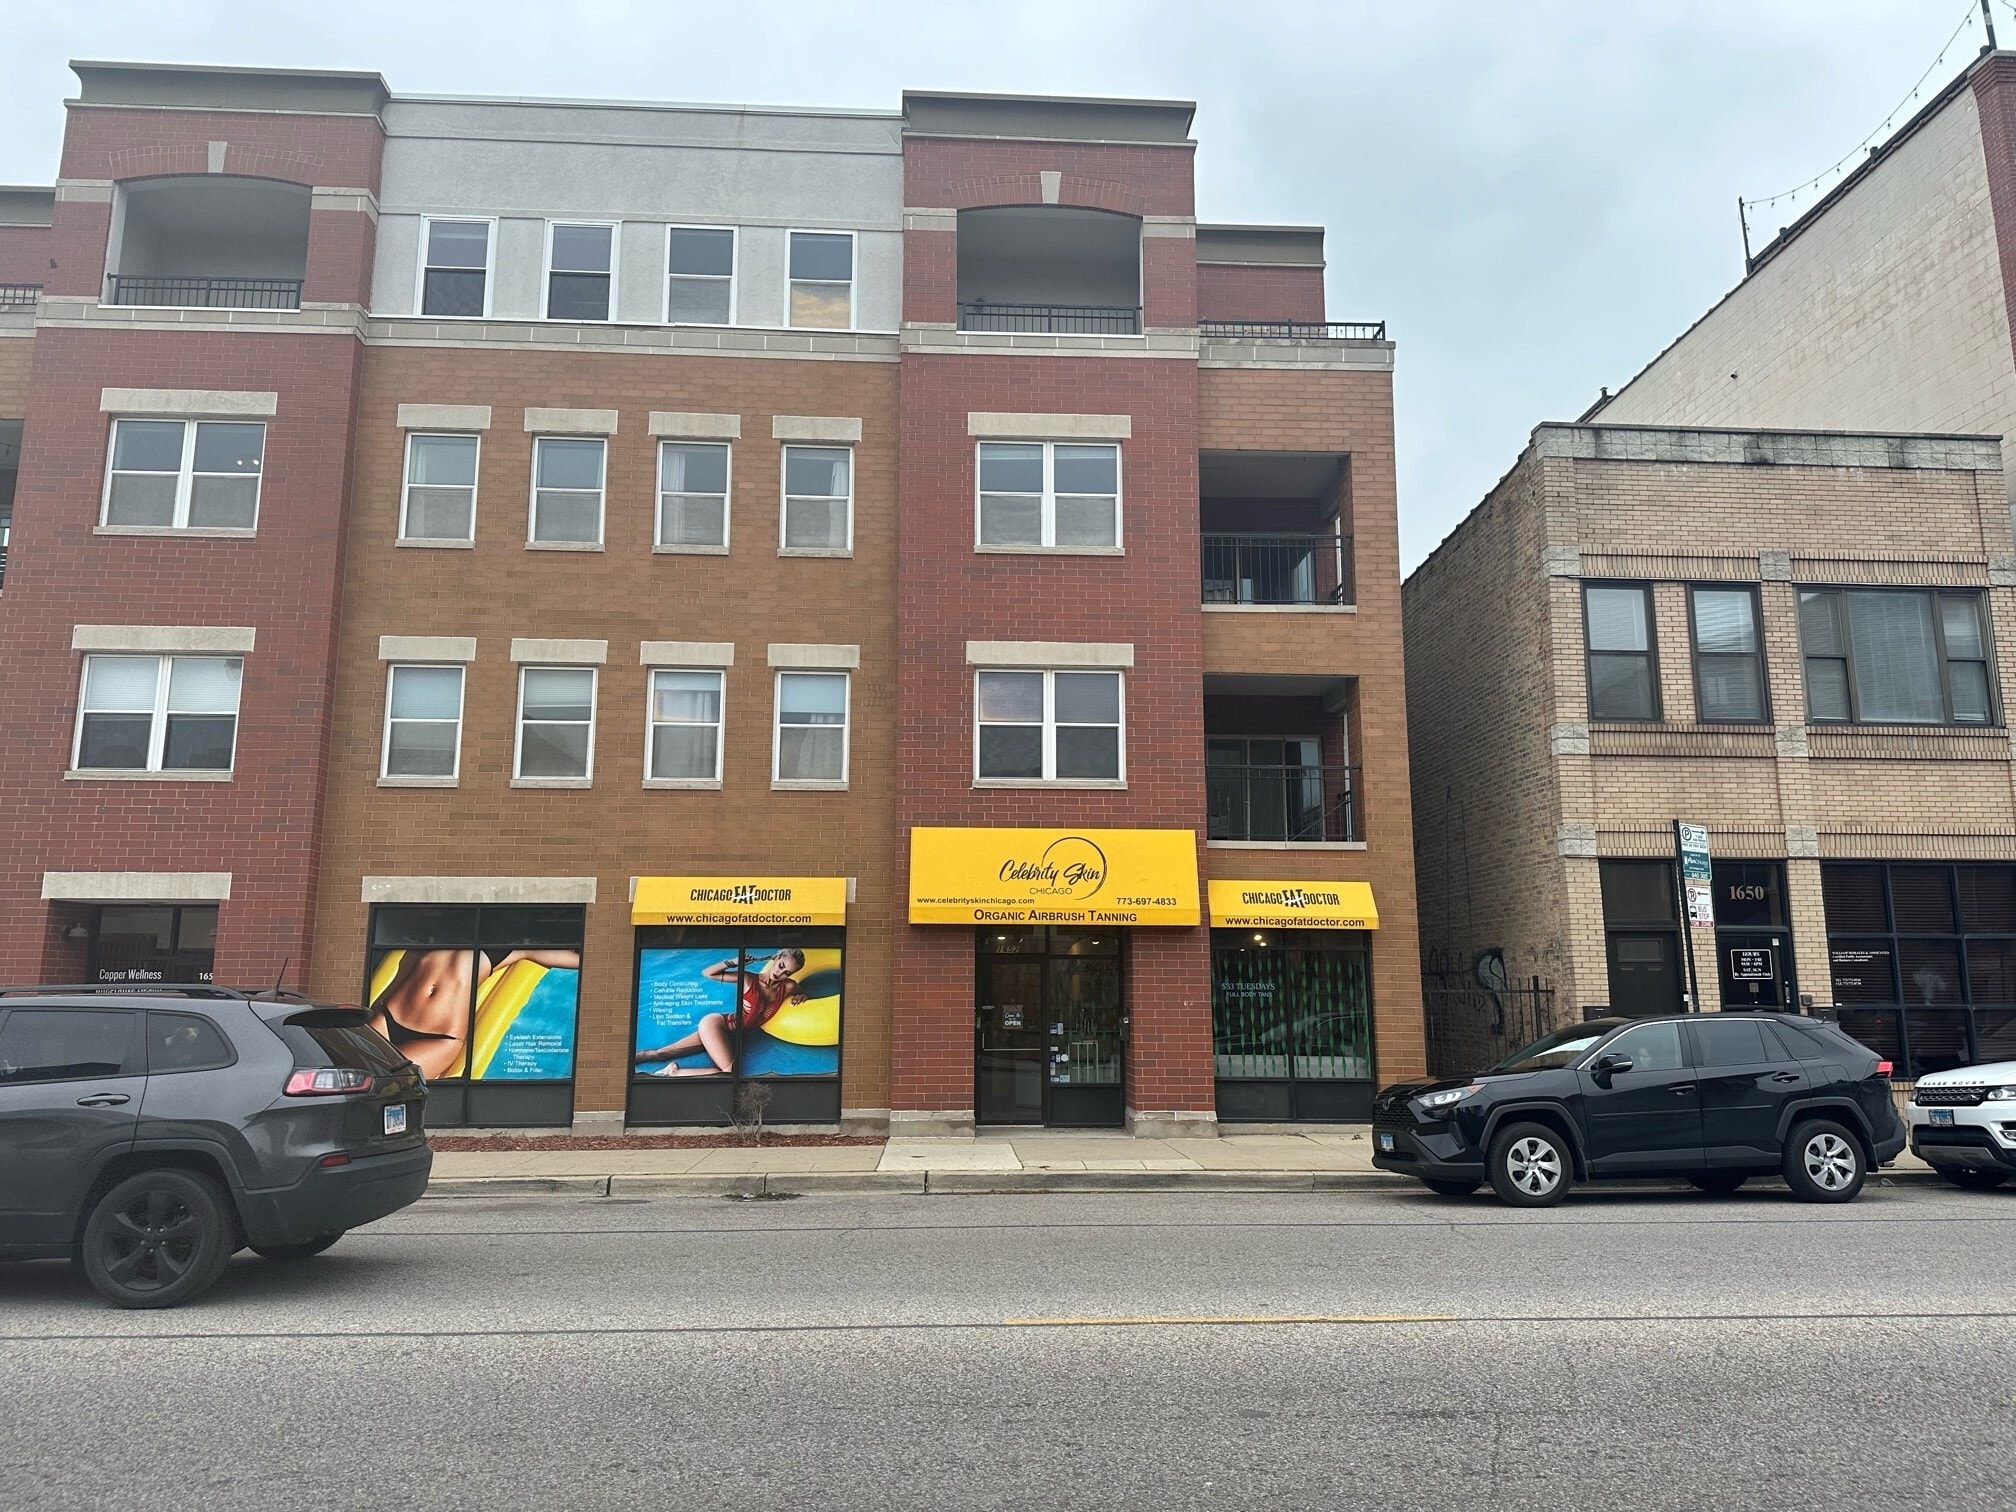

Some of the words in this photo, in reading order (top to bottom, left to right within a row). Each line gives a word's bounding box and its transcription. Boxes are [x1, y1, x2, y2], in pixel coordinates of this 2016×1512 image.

[999, 859, 1059, 887] Celebrity
[1063, 862, 1100, 886] Skin
[690, 888, 732, 901] CHICAGO
[732, 885, 757, 905] FAT
[755, 888, 792, 901] DOCTOR
[1029, 887, 1073, 895] CHICAGO
[1729, 885, 1764, 900] 1650
[916, 897, 1035, 905] www.celebrityskinchicago.com
[1116, 897, 1177, 906] 773-697-4833
[1242, 892, 1282, 904] CHICAGO
[1281, 889, 1306, 908] FAT
[1303, 893, 1340, 906] DOCTOR
[1697, 905, 1707, 913] BUS
[666, 913, 812, 925] www.chicagofatdoctor.com
[1225, 916, 1365, 927] www.chicagofatdoctor.com
[99, 968, 126, 981] Copper
[128, 968, 162, 980] Wellness
